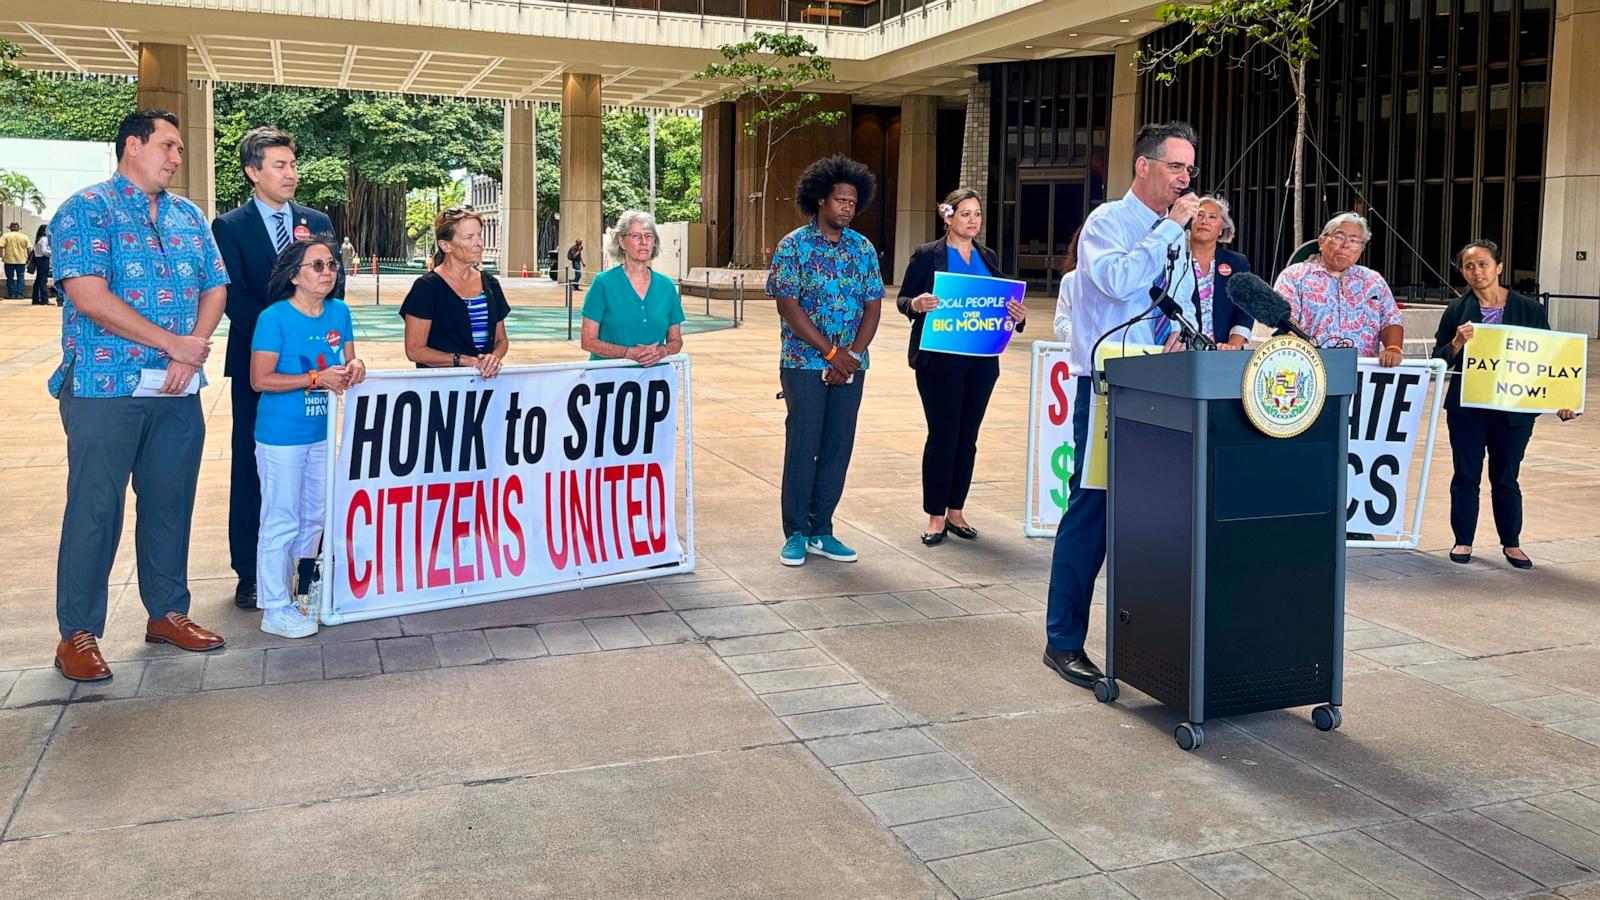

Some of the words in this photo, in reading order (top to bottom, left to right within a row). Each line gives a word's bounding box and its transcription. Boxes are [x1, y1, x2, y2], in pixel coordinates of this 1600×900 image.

[937, 298, 963, 308] OCAL
[965, 296, 1005, 308] PEOPLE
[962, 311, 981, 319] OVER
[932, 318, 953, 332] BIG
[956, 318, 1003, 332] MONEY
[1505, 338, 1539, 353] END
[1253, 343, 1277, 368] STATE
[1296, 343, 1320, 367] HAWAII
[1467, 357, 1500, 371] PAY
[1506, 360, 1530, 374] TO
[1537, 364, 1582, 378] PLAY
[1496, 382, 1547, 398] NOW!
[349, 389, 494, 481] HONK
[505, 392, 547, 466] to
[563, 379, 671, 461] STOP
[346, 474, 526, 599] CITIZENS
[545, 462, 667, 571] UNITED
